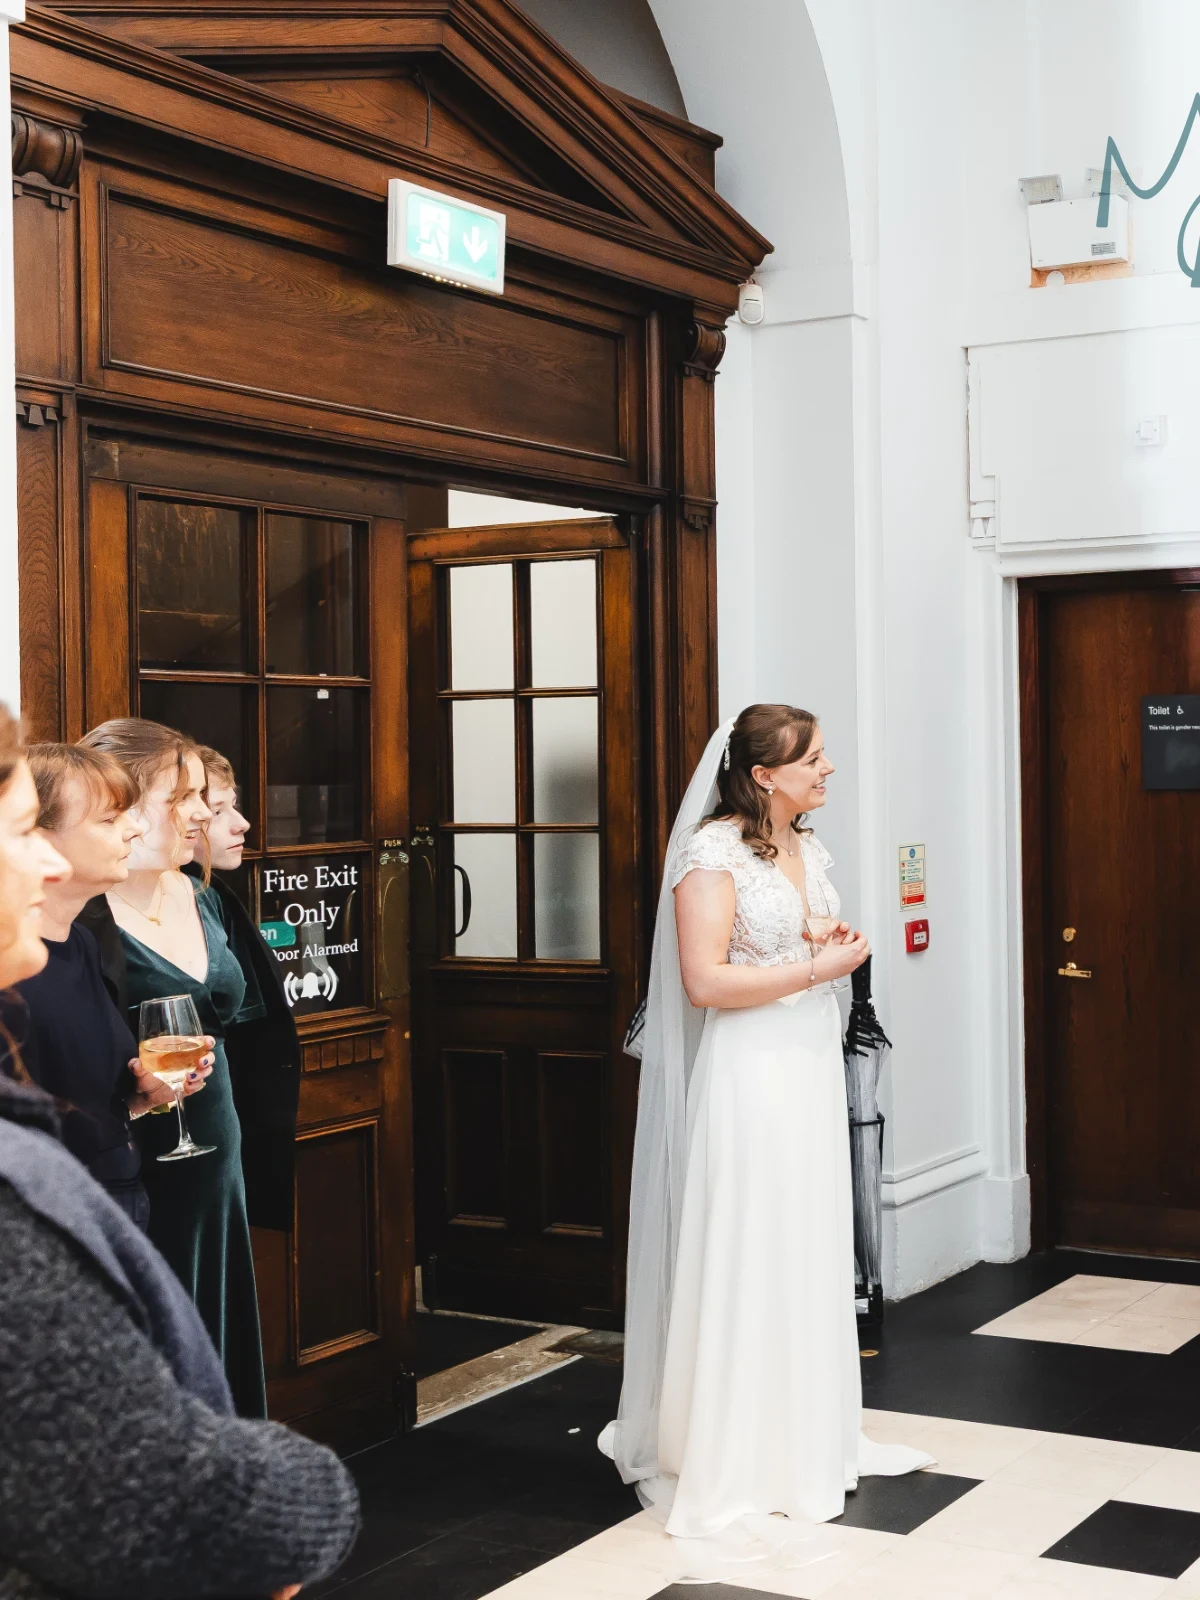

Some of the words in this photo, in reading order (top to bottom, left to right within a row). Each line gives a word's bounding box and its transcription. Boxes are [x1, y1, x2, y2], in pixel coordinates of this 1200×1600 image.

[1148, 706, 1170, 715] Toilet
[384, 839, 402, 847] PUSH
[264, 869, 308, 893] Fire
[314, 864, 358, 888] Exit
[284, 900, 340, 930] Only
[260, 928, 277, 941] en
[302, 938, 359, 958] Alarmed
